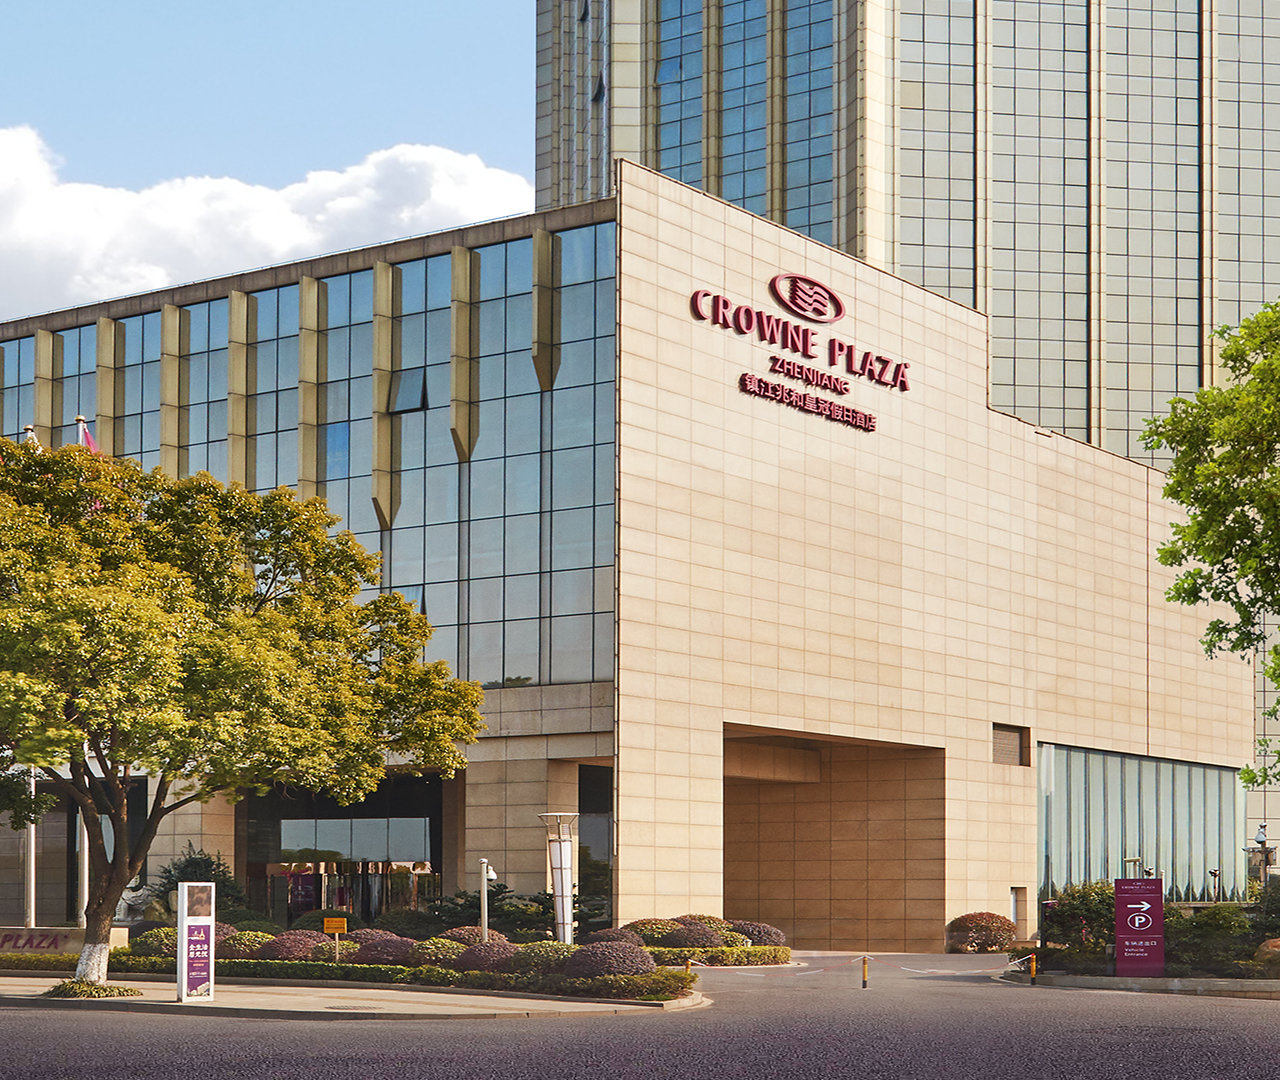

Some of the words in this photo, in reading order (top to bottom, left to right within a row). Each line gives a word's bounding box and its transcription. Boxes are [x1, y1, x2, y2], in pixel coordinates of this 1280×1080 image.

[690, 289, 819, 359] CROWNE
[829, 337, 911, 392] PLAZA
[770, 355, 851, 395] ZHENJIANG
[739, 372, 878, 433] 镇江兆和皇冠假日酒店
[0, 933, 60, 950] PLAZA
[1135, 916, 1146, 927] P
